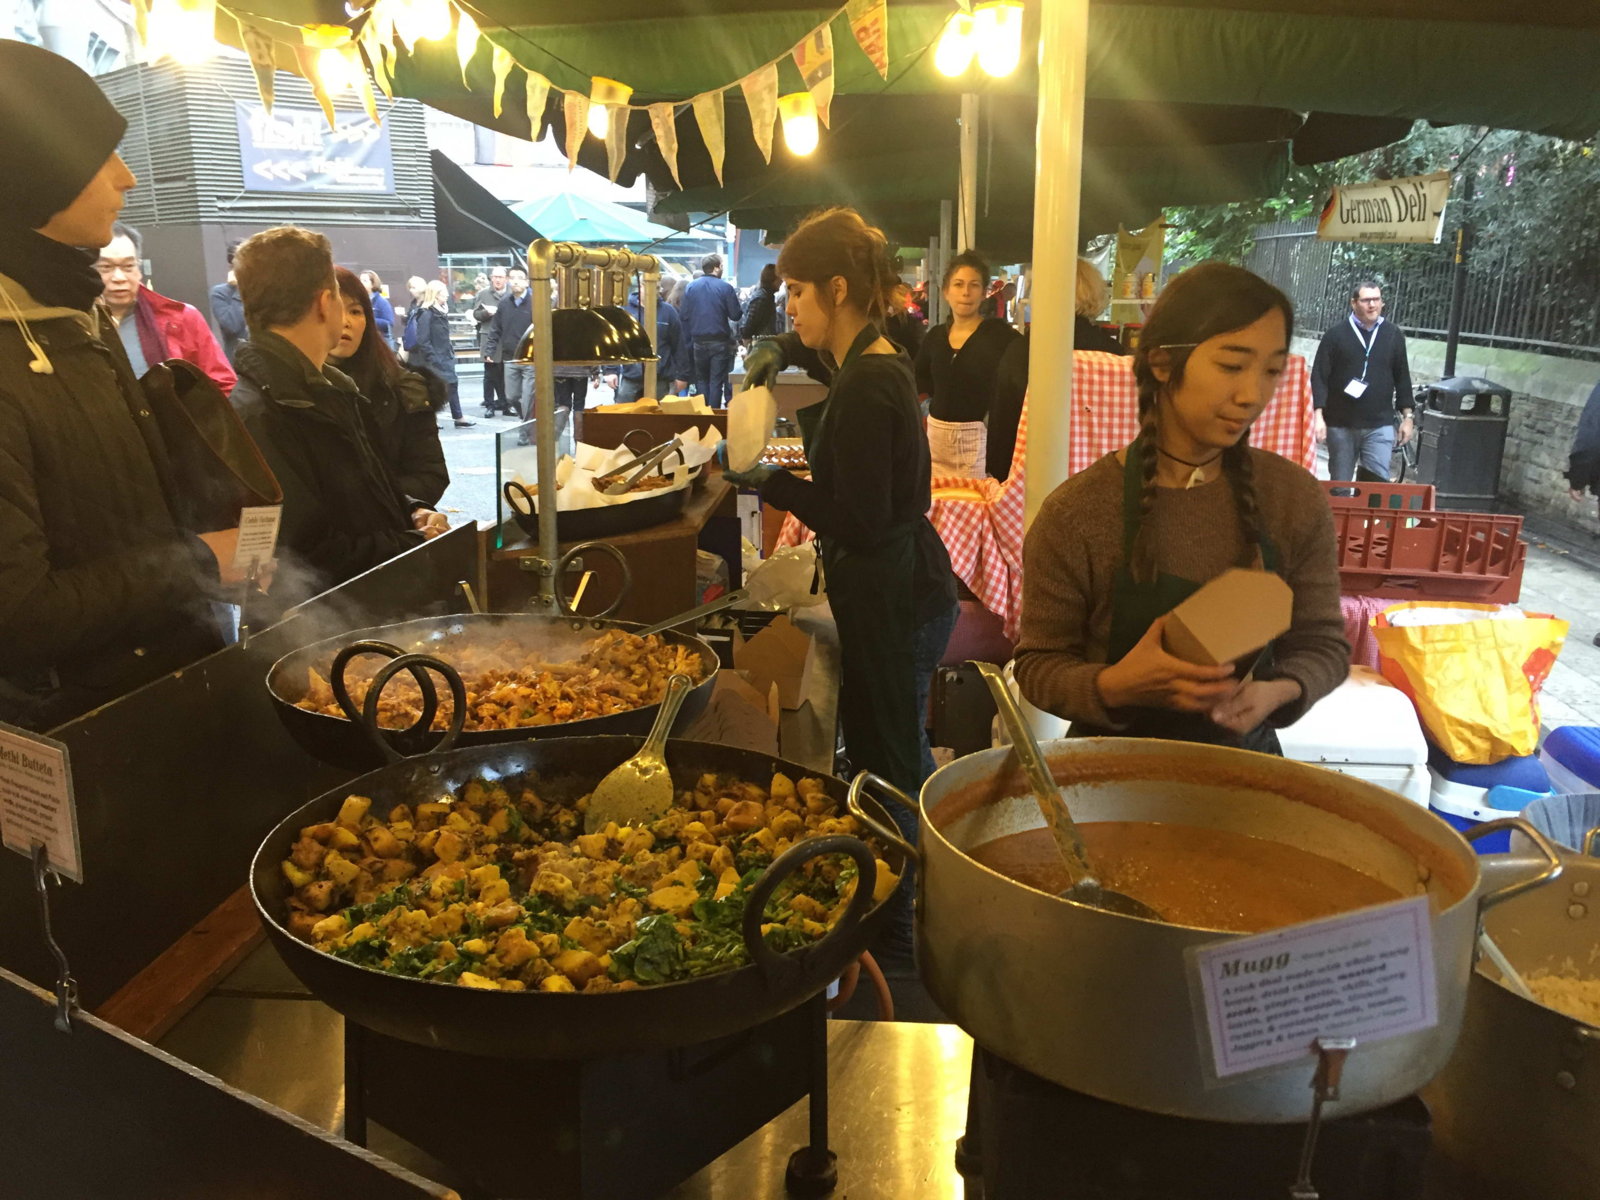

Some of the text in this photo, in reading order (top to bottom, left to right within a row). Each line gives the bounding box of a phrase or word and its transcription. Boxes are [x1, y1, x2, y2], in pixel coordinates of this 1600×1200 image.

[1340, 182, 1427, 224] German Deli
[1220, 952, 1289, 978] Mugg
[1337, 962, 1386, 980] mustard
